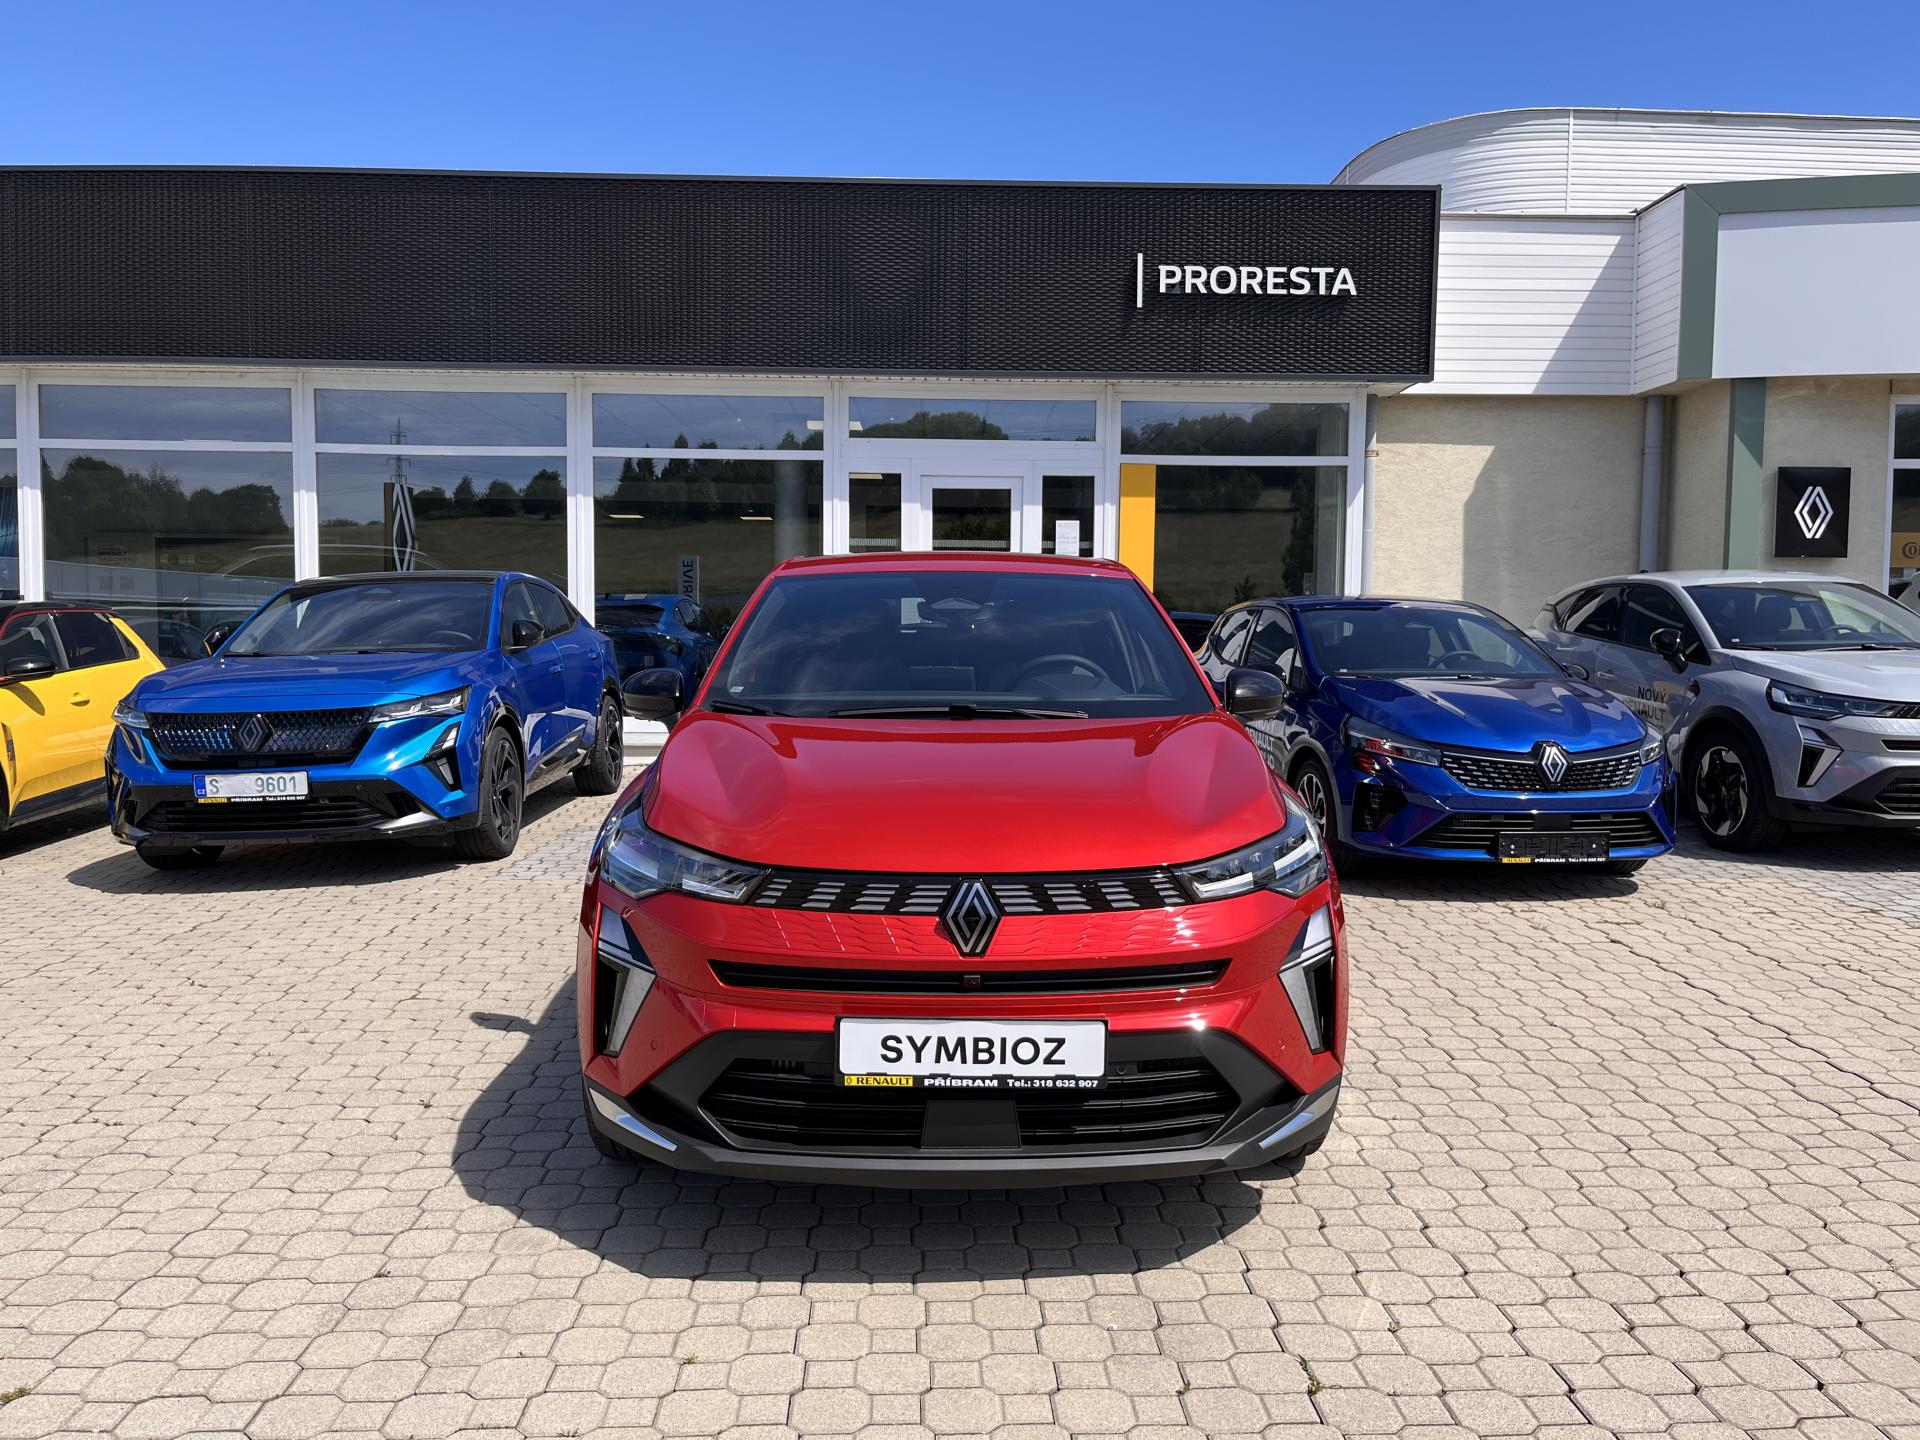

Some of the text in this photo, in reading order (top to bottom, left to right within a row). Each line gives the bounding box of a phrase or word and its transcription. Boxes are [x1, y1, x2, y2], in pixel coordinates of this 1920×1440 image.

[1159, 265, 1357, 296] PRORESTA
[1637, 686, 1667, 704] NOVÝ
[255, 776, 297, 793] 9601
[880, 1034, 1066, 1065] SYMBIOZ
[856, 1076, 912, 1086] RENAULT
[923, 1076, 998, 1087] PŘÍBRAM
[1032, 1079, 1053, 1087] 318
[1055, 1079, 1076, 1087] 632
[1078, 1079, 1099, 1088] 907
